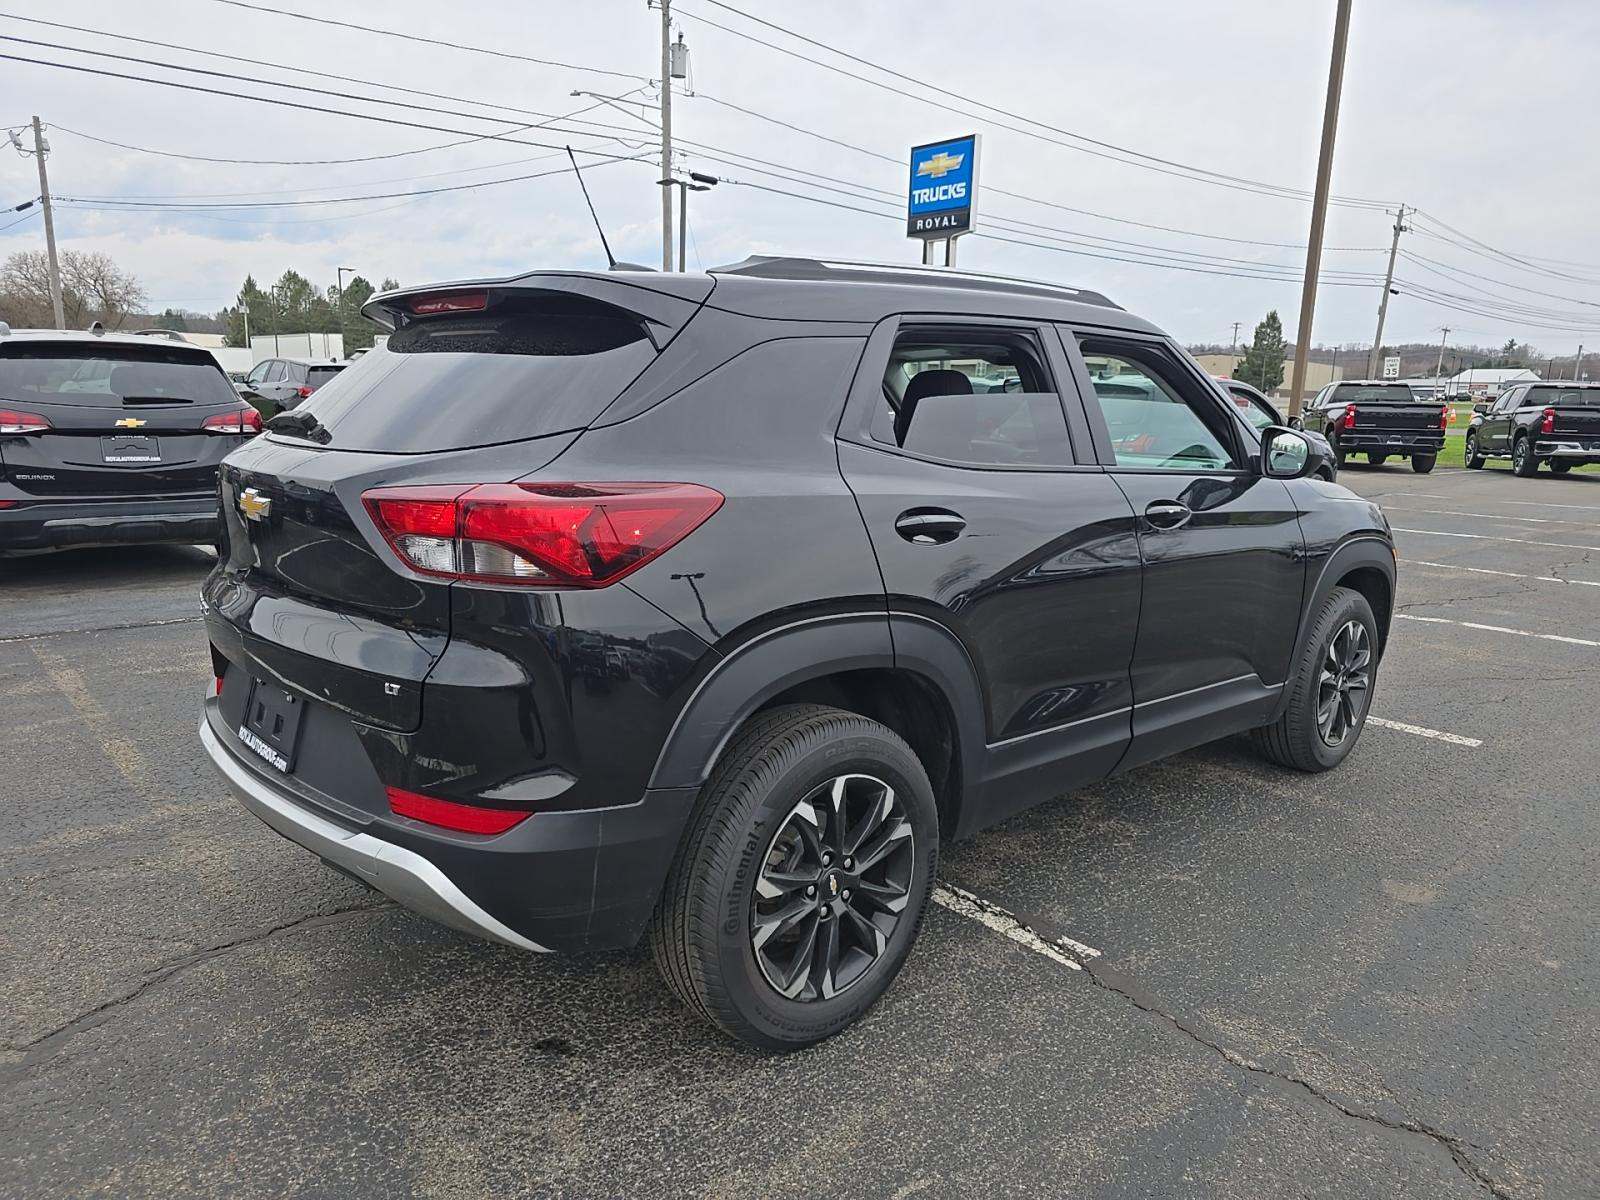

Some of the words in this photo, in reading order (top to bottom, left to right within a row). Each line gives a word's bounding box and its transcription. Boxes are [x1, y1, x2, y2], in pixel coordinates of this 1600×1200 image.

[912, 182, 966, 204] TRUCKS
[917, 215, 958, 230] ROYAL
[384, 682, 401, 696] LT
[724, 831, 761, 936] Continental
